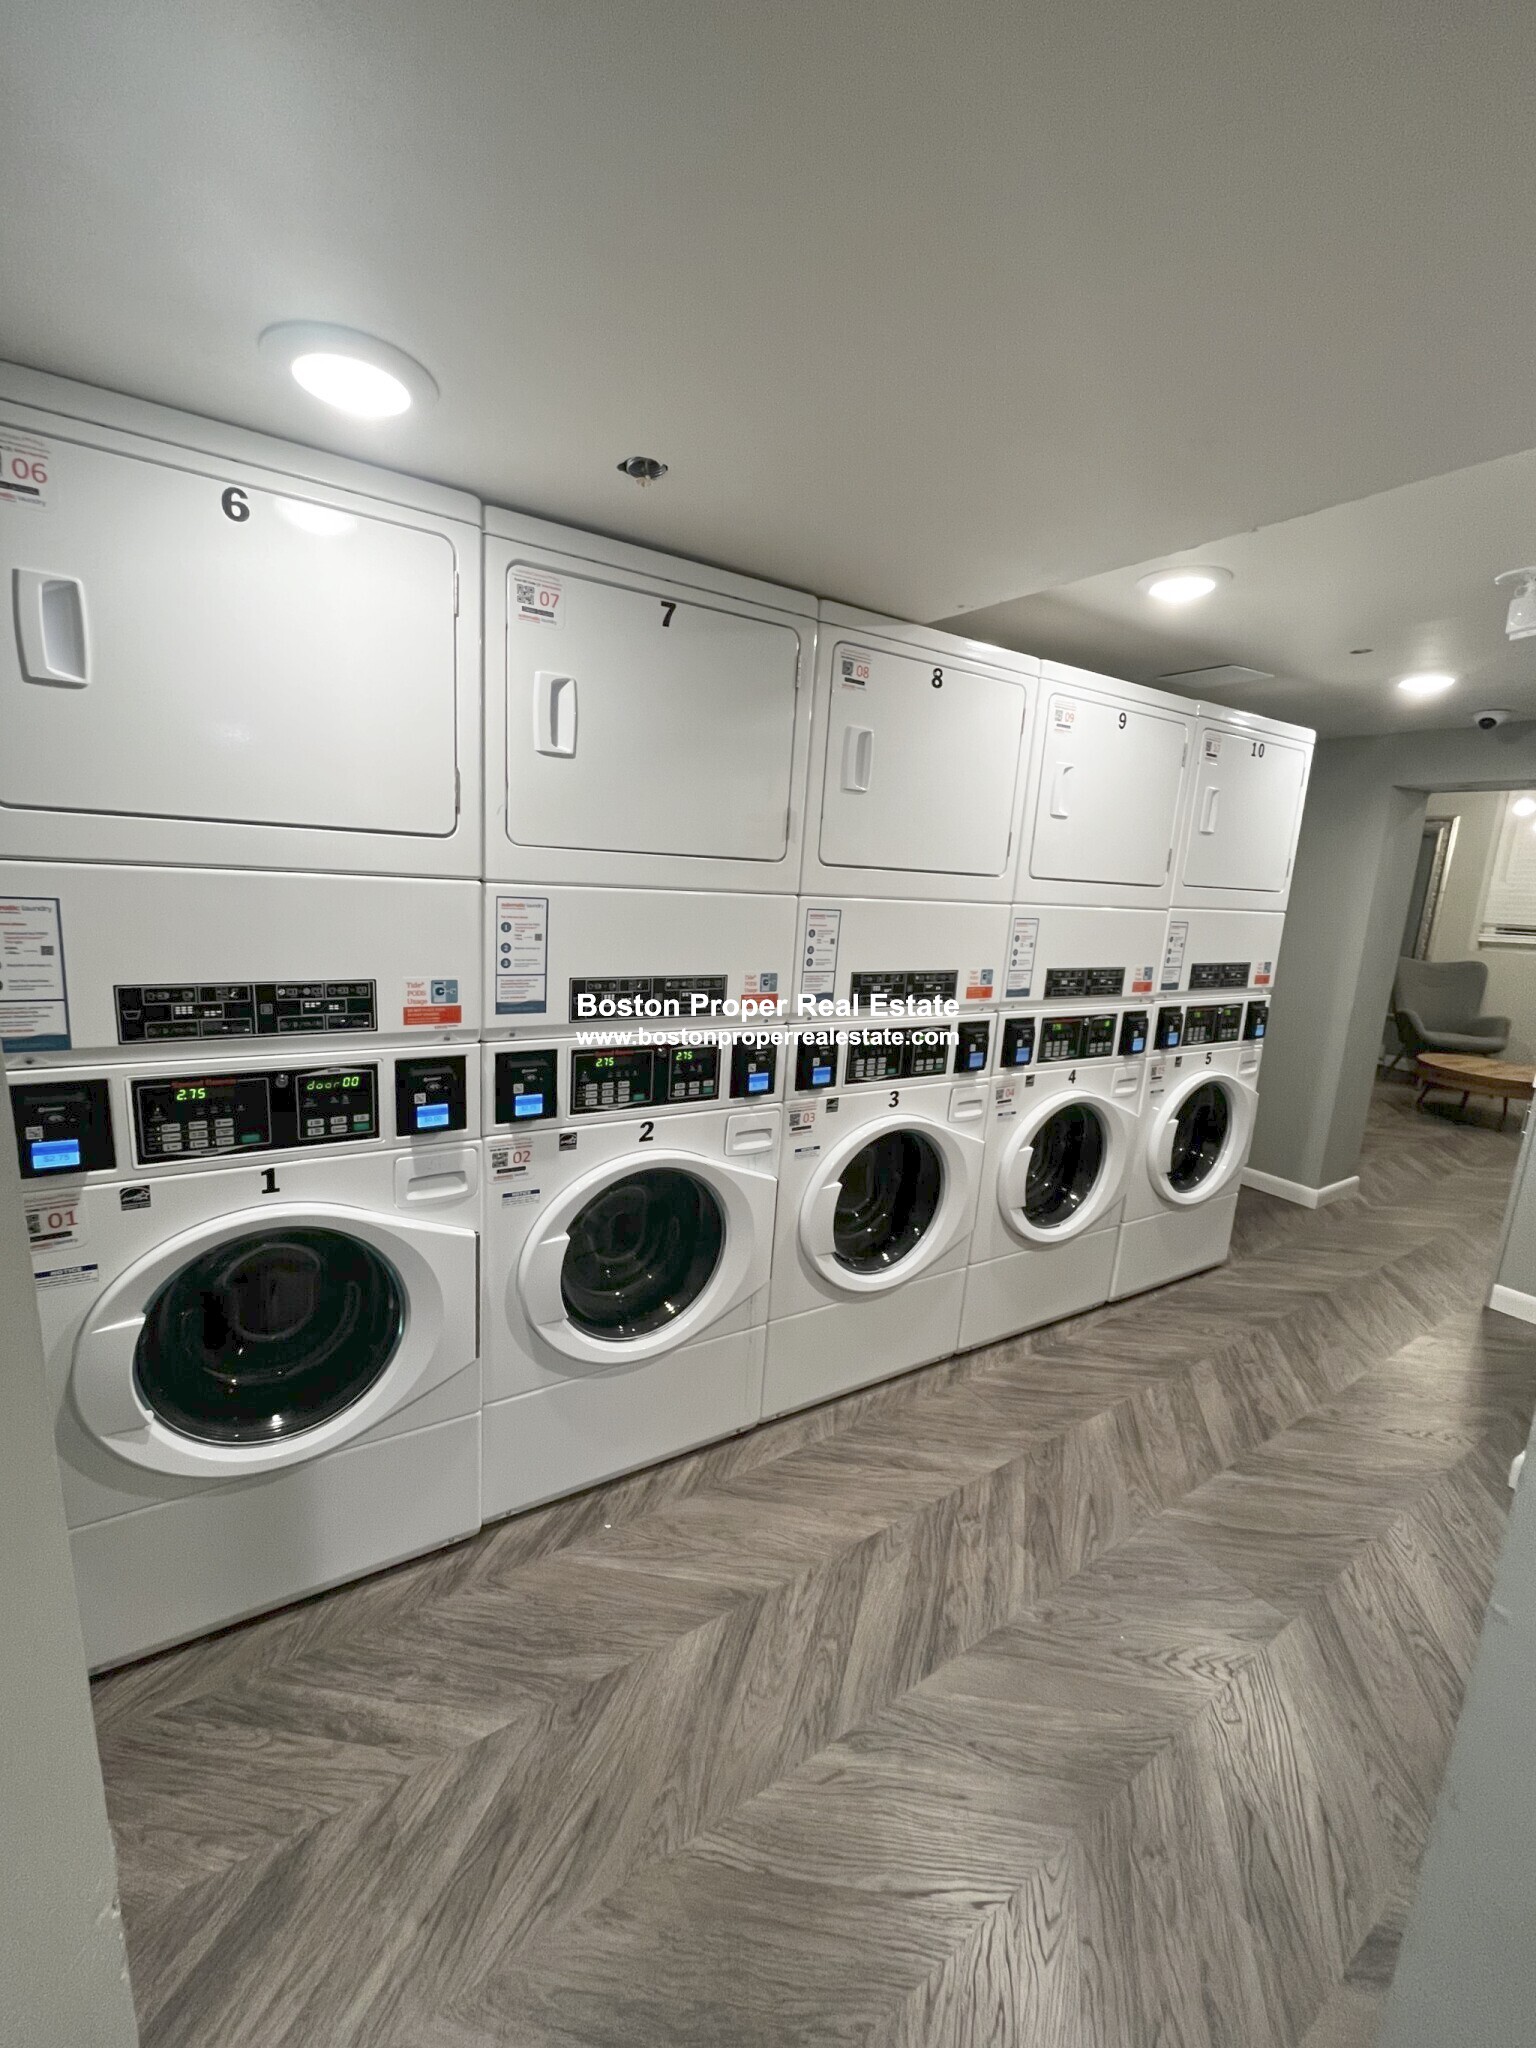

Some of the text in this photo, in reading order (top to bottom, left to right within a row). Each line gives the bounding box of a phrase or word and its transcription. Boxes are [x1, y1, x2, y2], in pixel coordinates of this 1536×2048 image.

[12, 458, 48, 484] 06
[222, 486, 250, 523] 6
[540, 591, 560, 608] 07
[661, 601, 677, 628] 7
[856, 665, 870, 679] 08
[931, 668, 943, 689] 8
[1118, 712, 1128, 730] 9
[1251, 742, 1265, 758] 10
[1205, 1052, 1213, 1065] 5
[1068, 1069, 1077, 1084] 4
[176, 1088, 206, 1101] 2.75
[888, 1091, 899, 1108] 3
[803, 1112, 816, 1124] 03
[638, 1121, 655, 1143] 2
[513, 1150, 531, 1164] 02
[261, 1167, 280, 1194] 1
[48, 1210, 79, 1229] 01
